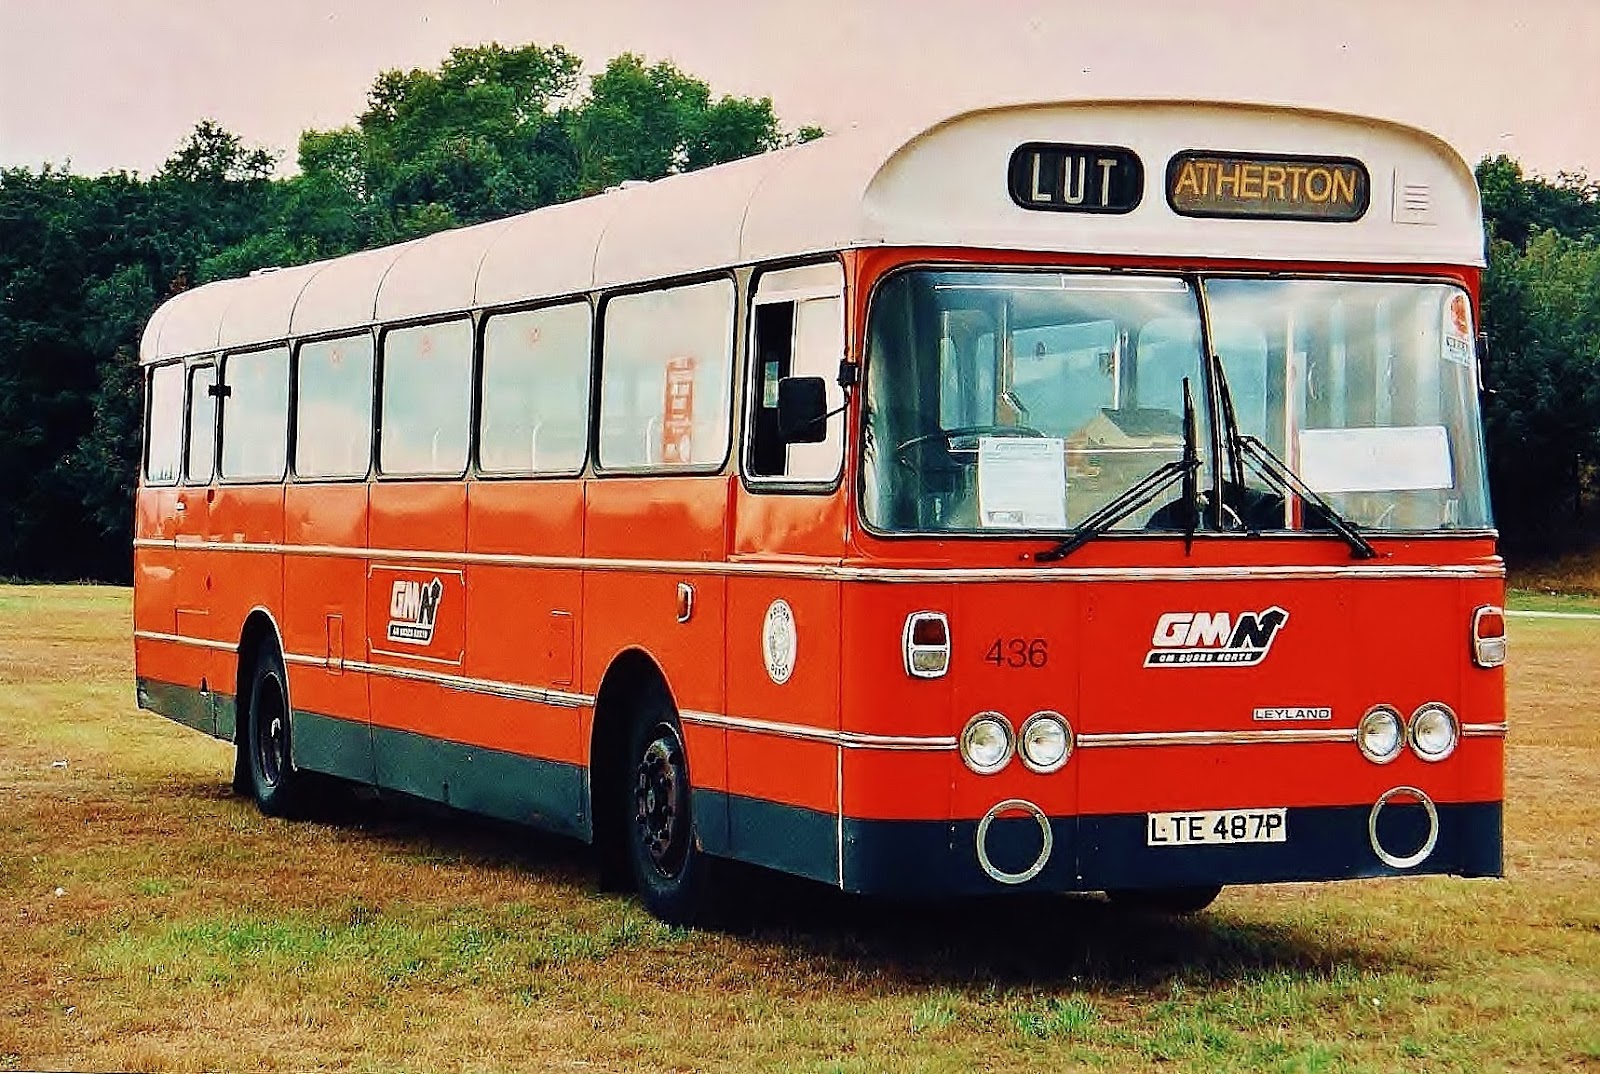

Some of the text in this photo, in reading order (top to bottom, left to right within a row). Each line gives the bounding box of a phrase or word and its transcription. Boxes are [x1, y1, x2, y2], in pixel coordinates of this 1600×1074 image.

[1031, 153, 1118, 207] LUT
[1174, 162, 1357, 203] ATHERTON
[1152, 606, 1288, 649] GMN
[984, 638, 1048, 668] 436
[1255, 709, 1330, 719] LEYLAND
[1151, 813, 1283, 842] LTE 487P
